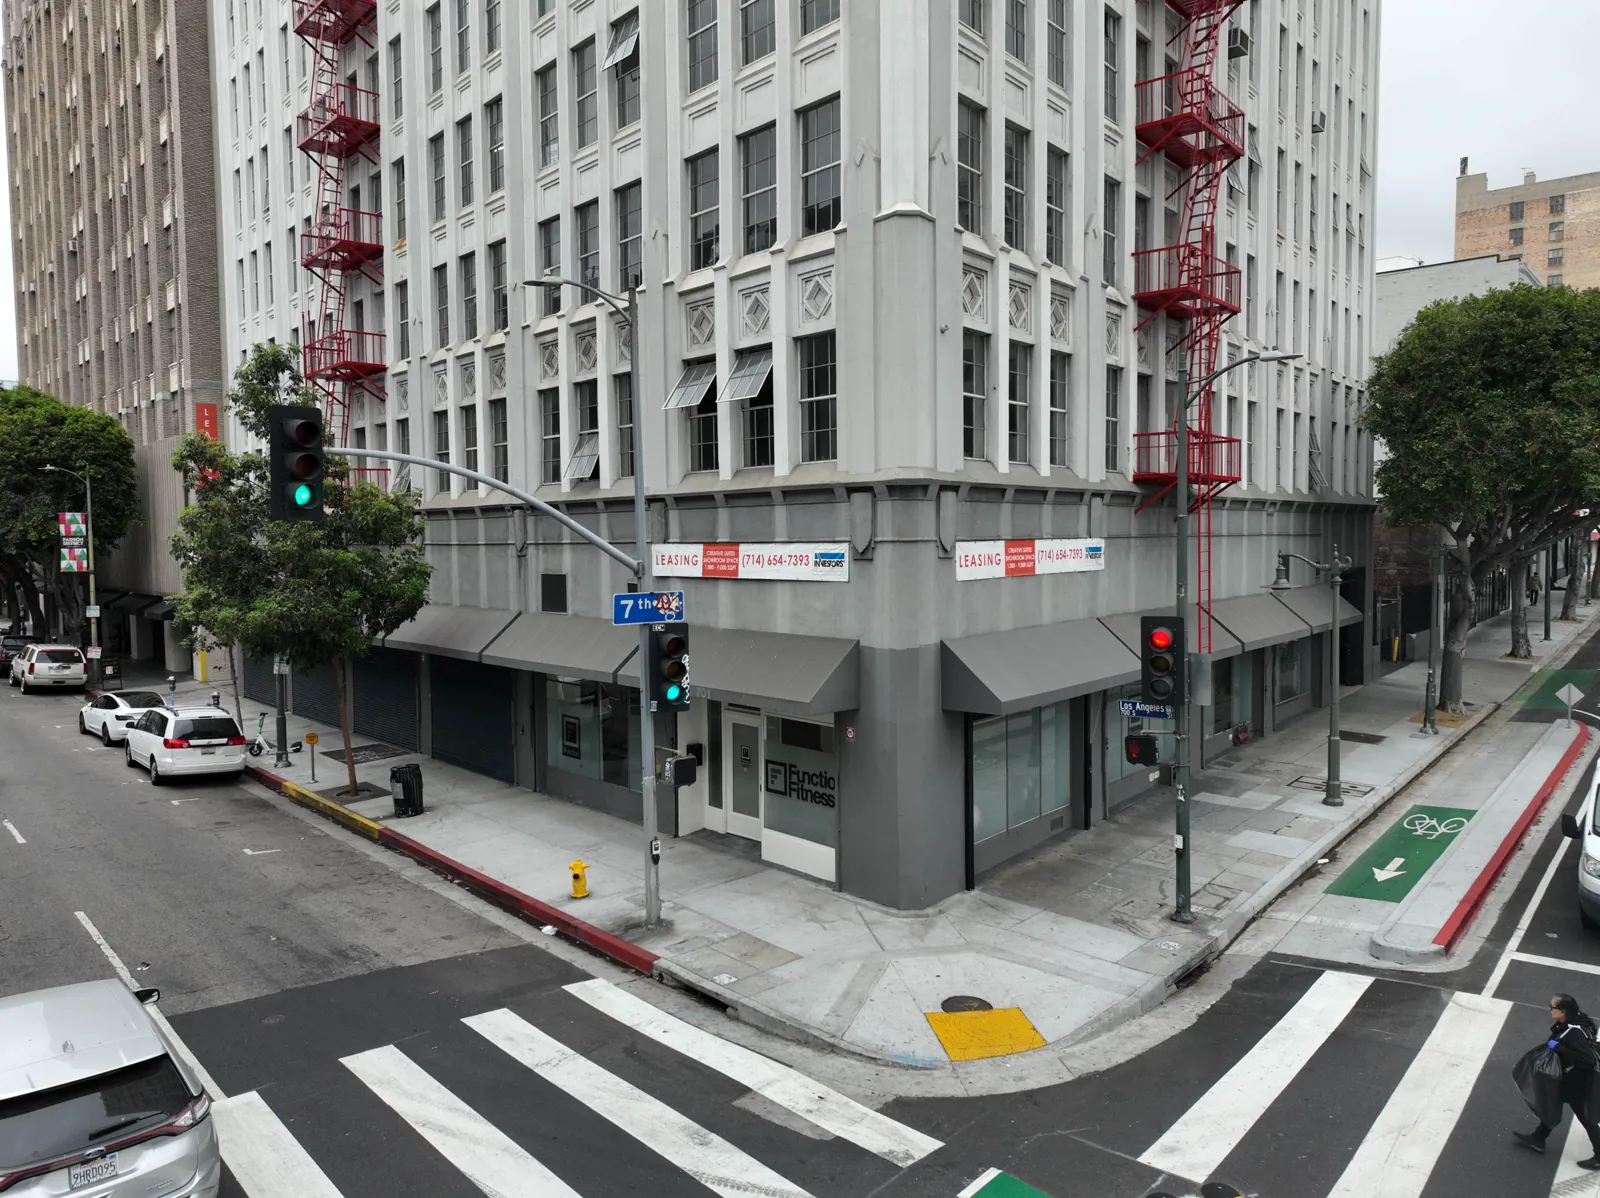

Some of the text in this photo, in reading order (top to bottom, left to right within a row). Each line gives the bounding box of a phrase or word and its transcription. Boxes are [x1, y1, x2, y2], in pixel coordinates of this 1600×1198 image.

[656, 554, 698, 566] LEASING
[742, 554, 810, 568] (714) 654-7393
[959, 552, 1002, 568] LEASING
[1038, 548, 1082, 563] (714) 654-7393
[814, 560, 844, 568] INVESTORS
[1120, 701, 1164, 714] Los Angeles
[788, 764, 835, 790] Functio
[788, 780, 835, 808] Fitness
[72, 1161, 116, 1187] 9HRD095
